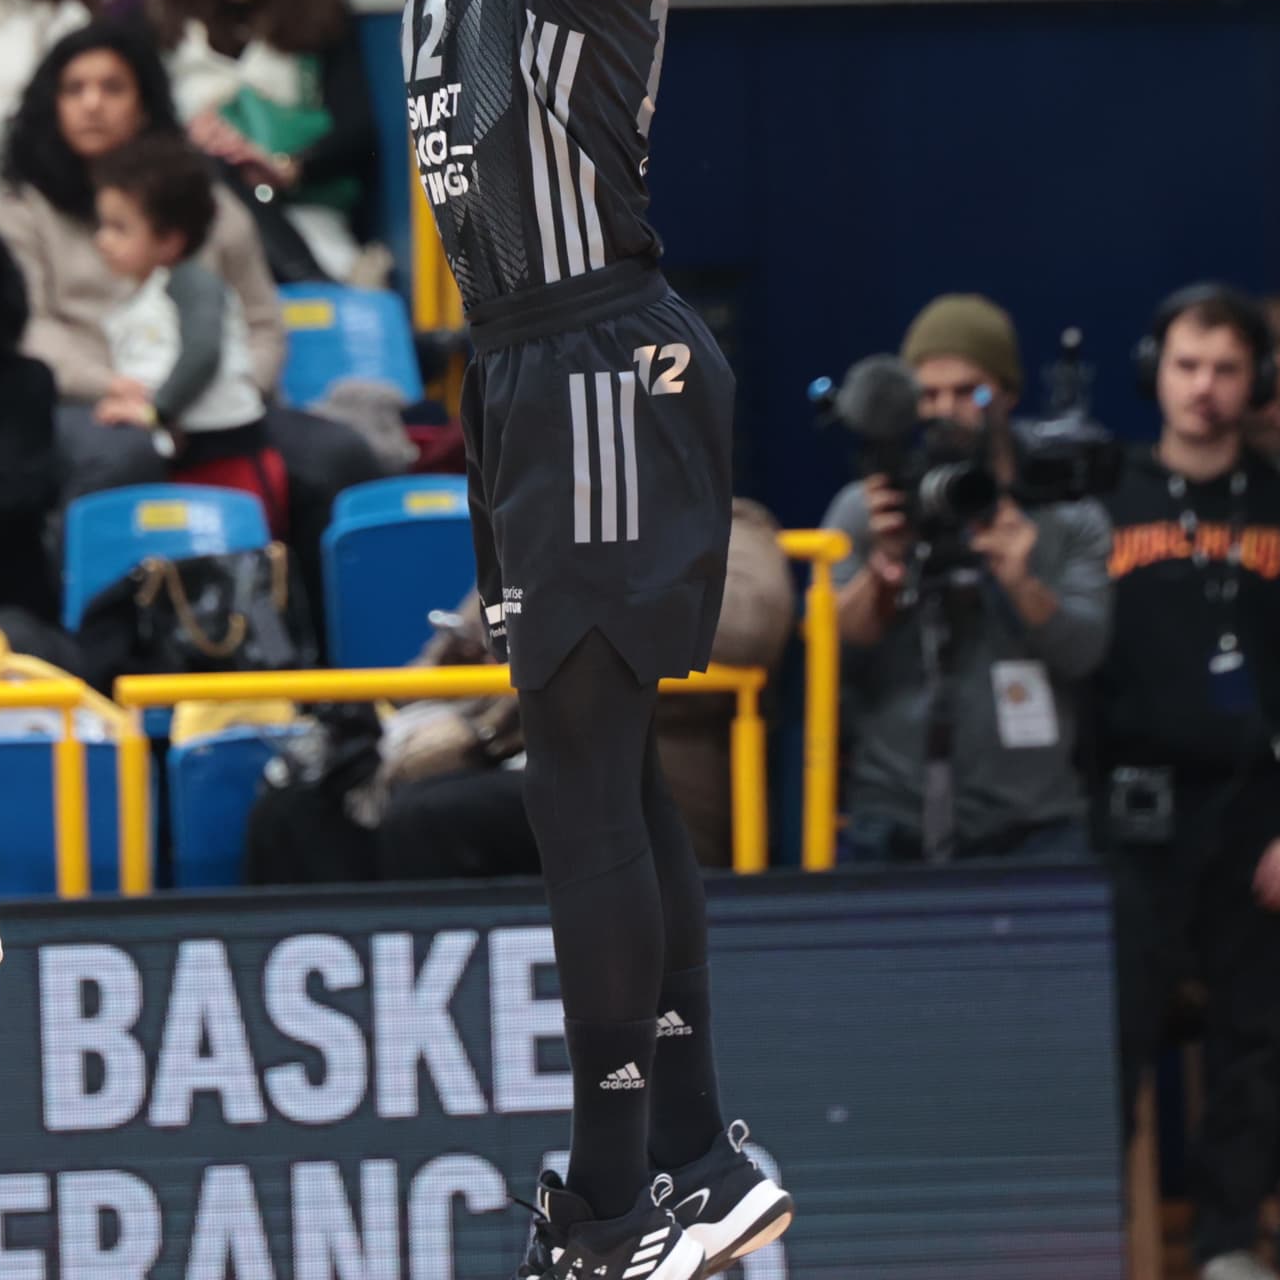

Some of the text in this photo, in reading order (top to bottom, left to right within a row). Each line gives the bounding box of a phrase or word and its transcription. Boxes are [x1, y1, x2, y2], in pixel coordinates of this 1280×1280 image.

[633, 343, 690, 396] 12
[38, 926, 573, 1131] BASKE
[600, 1078, 646, 1089] adidas
